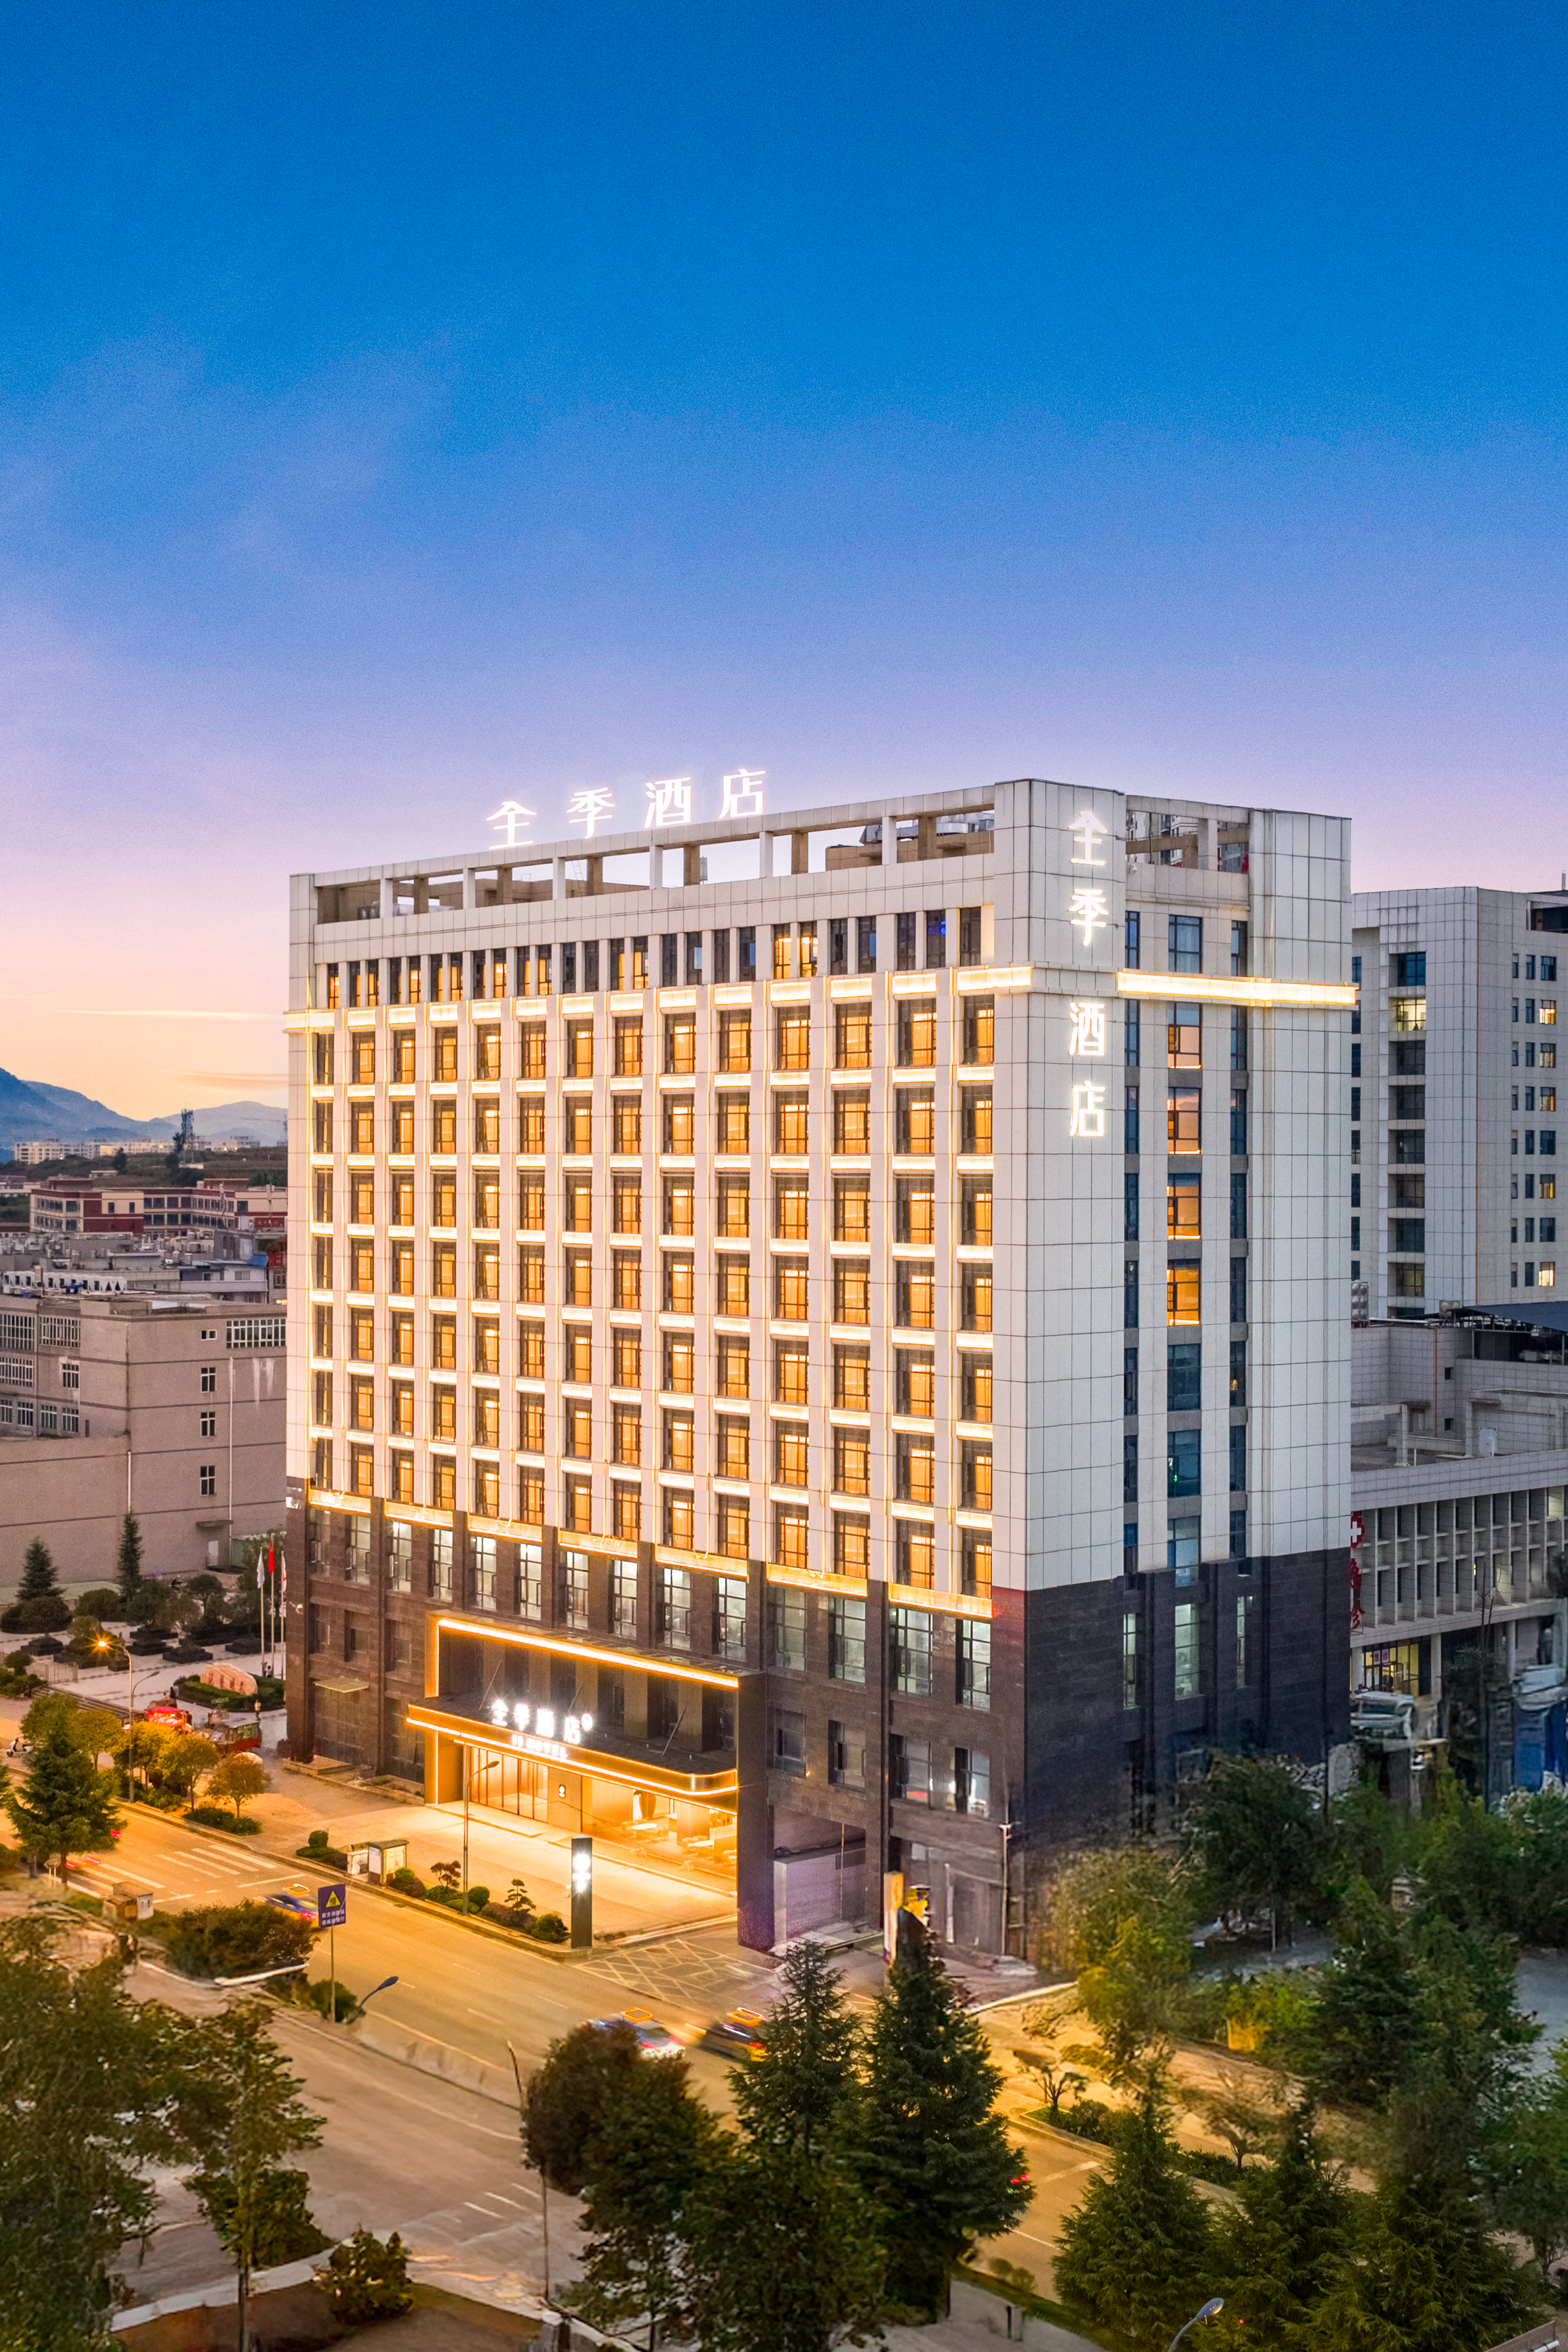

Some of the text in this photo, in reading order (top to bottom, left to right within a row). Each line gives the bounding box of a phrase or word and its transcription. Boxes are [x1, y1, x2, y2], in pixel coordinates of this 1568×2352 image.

[485, 769, 766, 850] 全季酒店
[1068, 810, 1109, 1137] 全季酒店
[1374, 1651, 1389, 1662] 急诊
[491, 1699, 581, 1744] 全季酒店
[527, 1738, 568, 1759] HOTEL
